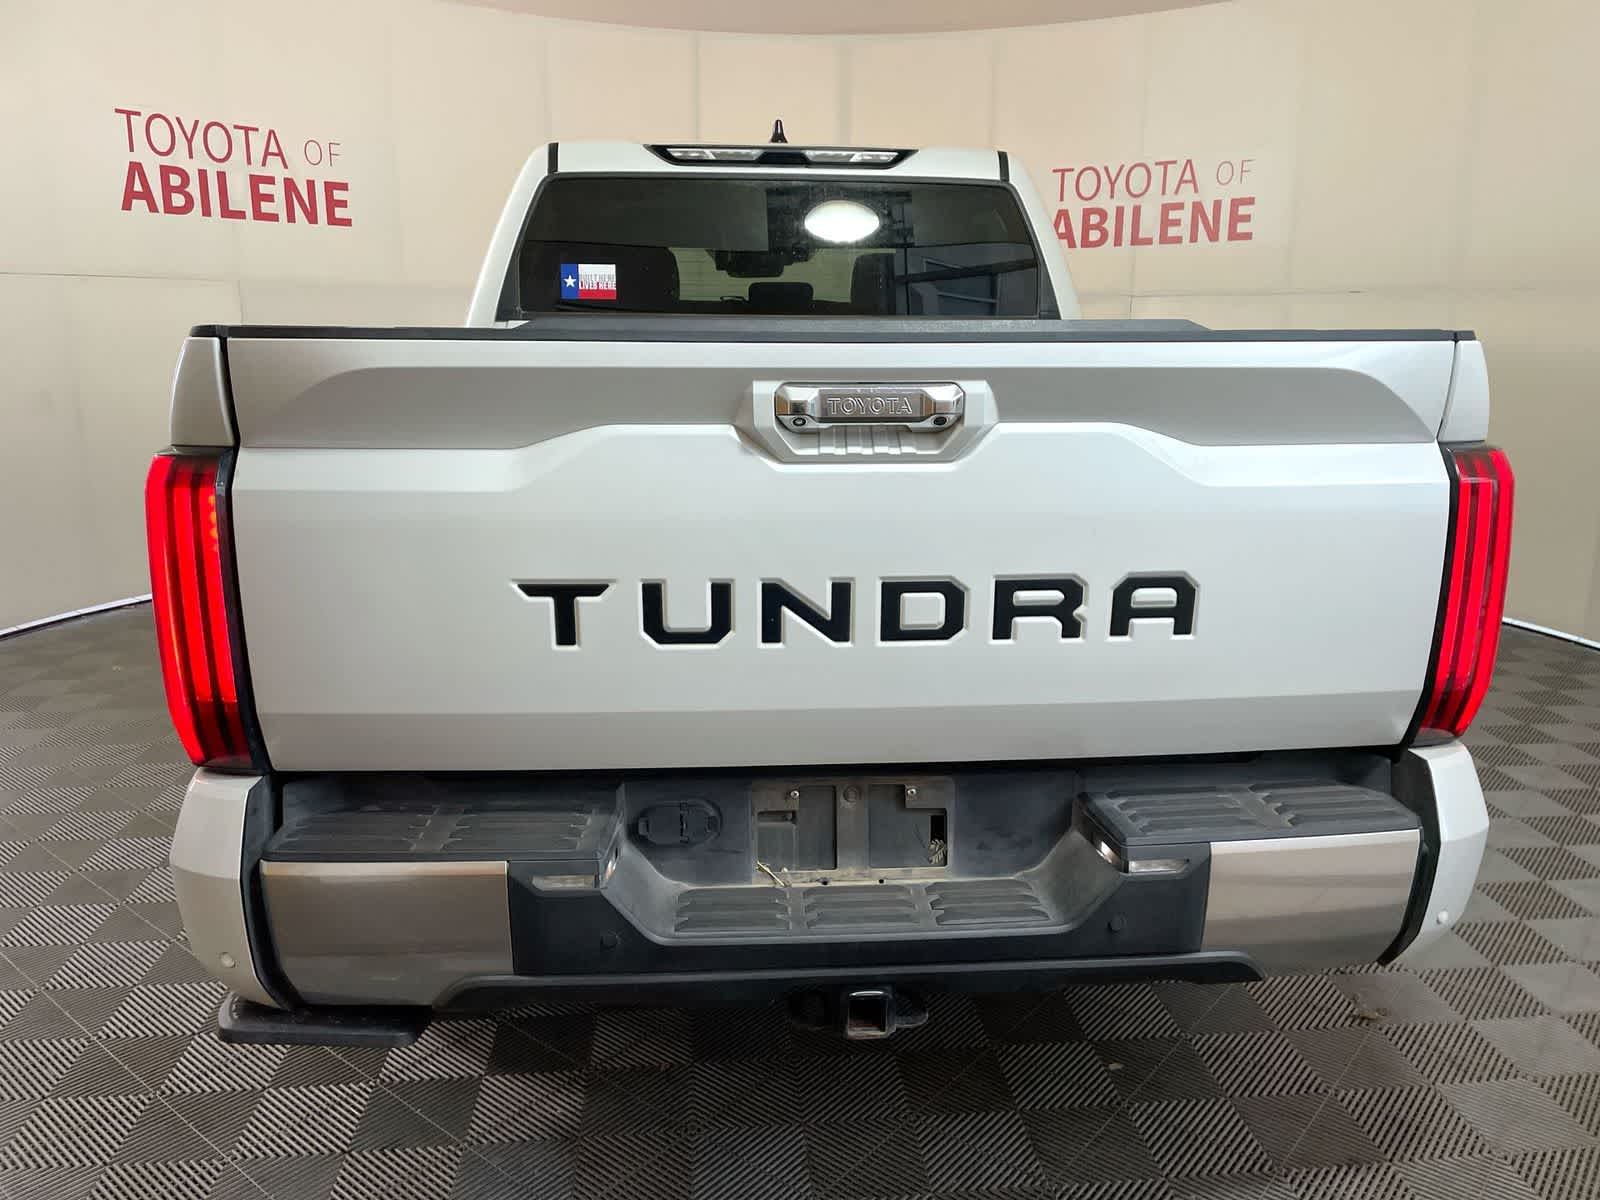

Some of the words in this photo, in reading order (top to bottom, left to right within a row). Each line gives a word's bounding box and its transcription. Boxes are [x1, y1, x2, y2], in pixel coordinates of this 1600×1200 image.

[114, 108, 288, 169] TOYOTA
[303, 139, 341, 167] OF
[121, 161, 352, 227] ABILENE
[1052, 159, 1199, 202] TOYOTA
[1216, 159, 1256, 186] OF
[1053, 197, 1256, 249] ABILENE
[598, 281, 617, 290] HERE
[827, 397, 913, 415] TOYOTA
[512, 572, 1201, 649] TUNDRA
